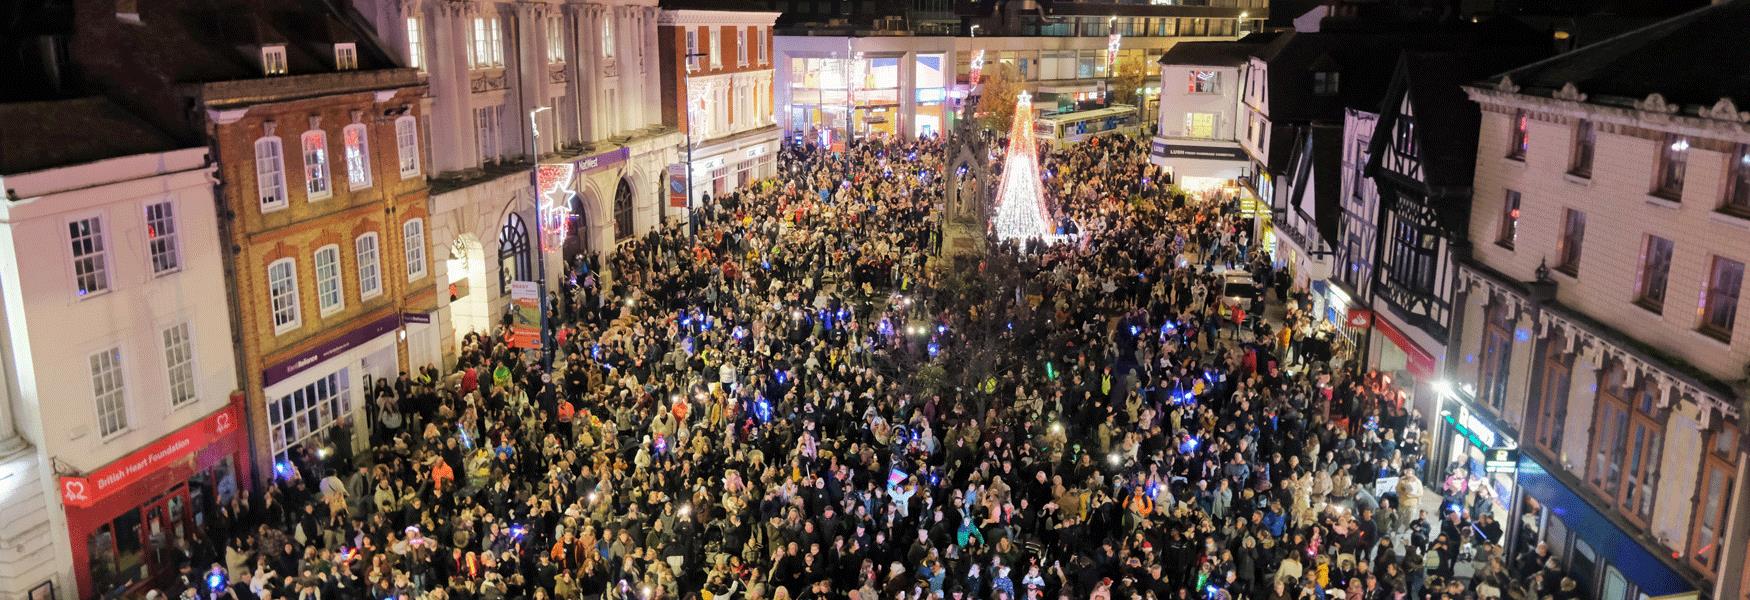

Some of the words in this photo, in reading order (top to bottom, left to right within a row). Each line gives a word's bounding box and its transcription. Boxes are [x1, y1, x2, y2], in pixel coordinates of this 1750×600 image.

[578, 156, 598, 170] NatWest
[98, 470, 125, 489] British
[126, 457, 149, 476] Heart
[149, 437, 190, 464] Foundation
